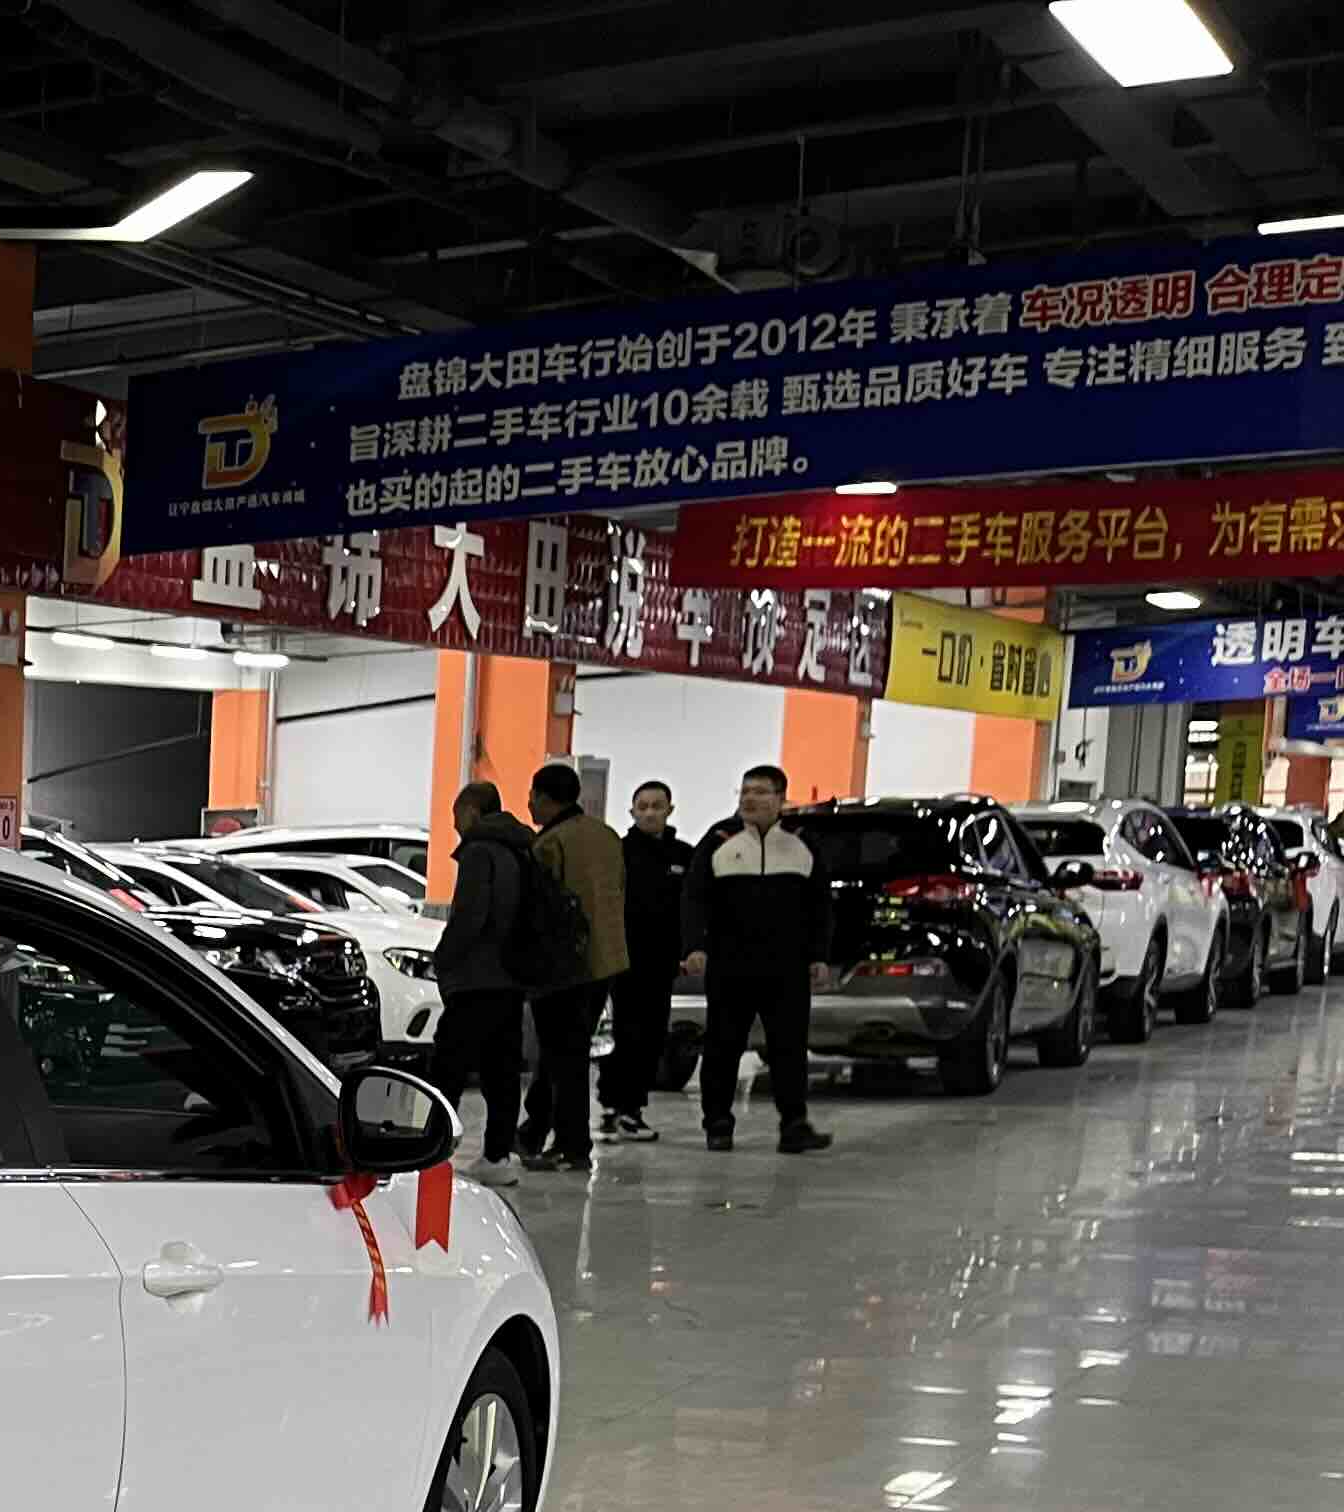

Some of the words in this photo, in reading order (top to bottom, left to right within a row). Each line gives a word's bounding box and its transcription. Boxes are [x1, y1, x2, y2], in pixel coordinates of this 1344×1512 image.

[398, 309, 877, 399] 盘锦大田车行始创于2012年
[1019, 270, 1196, 332] 车况透明
[1206, 253, 1344, 316] 合理定
[349, 379, 769, 462] 旨深耕二手车行业10余载
[782, 353, 1027, 415] 甄选品质好车
[1043, 327, 1307, 388] 专注精细服务
[345, 437, 808, 516] 也买的起的二手车放心品牌。
[1263, 665, 1344, 693] 全场一
